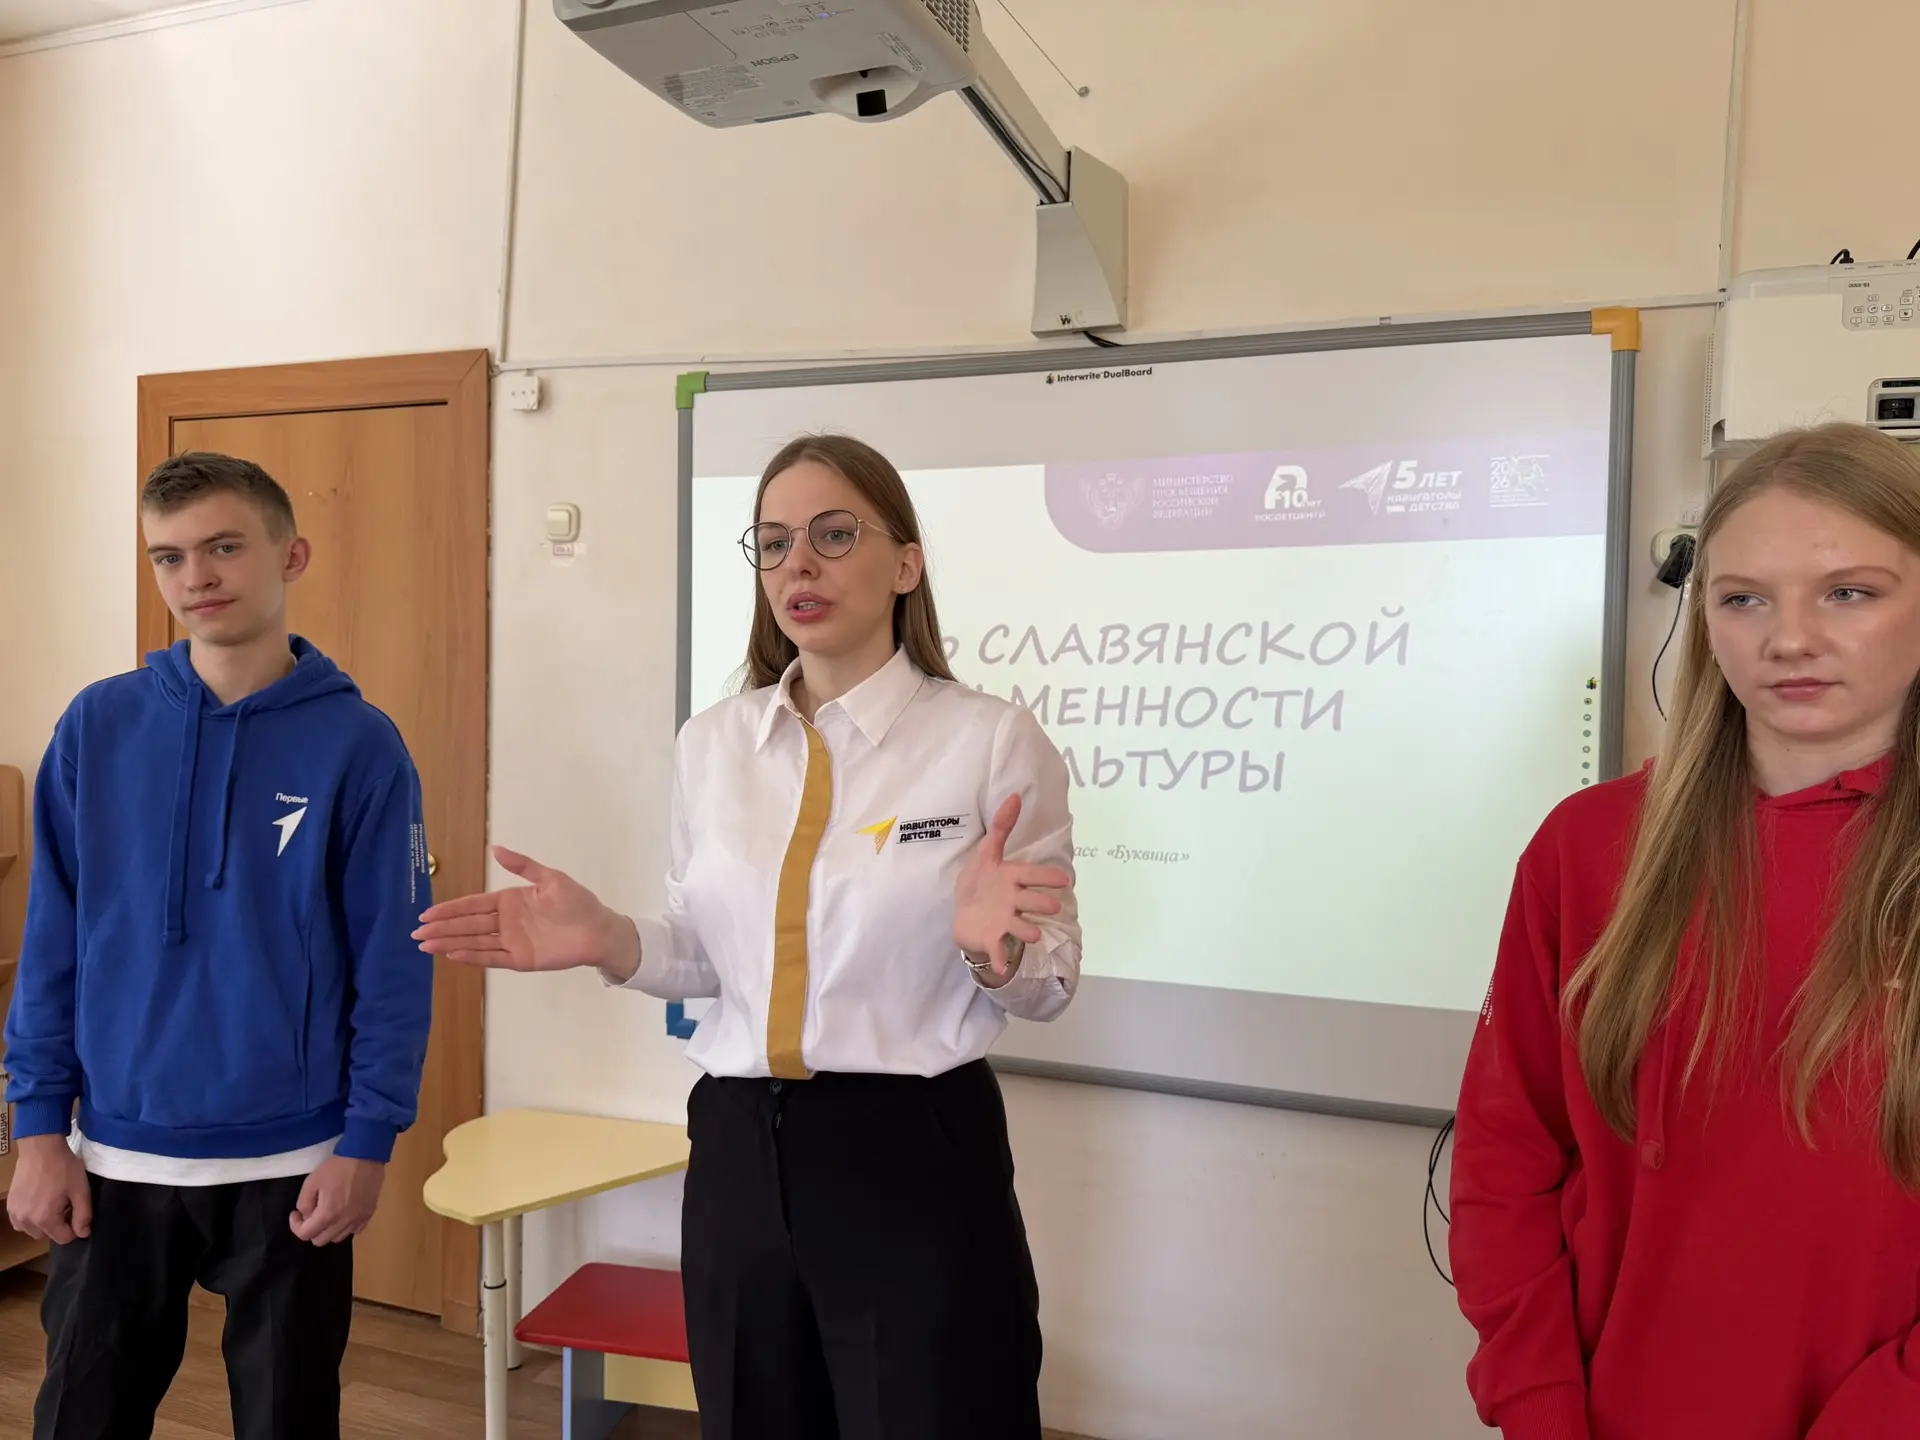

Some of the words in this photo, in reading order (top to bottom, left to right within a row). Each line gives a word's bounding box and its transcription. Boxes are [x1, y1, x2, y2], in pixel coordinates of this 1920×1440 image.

[750, 53, 799, 67] EPSON
[1057, 372, 1101, 383] Interwrite
[1103, 366, 1153, 379] DualBoard
[1392, 459, 1418, 490] 5
[1418, 470, 1464, 489] ЛЕТ
[978, 605, 1410, 667] СЛАВЯНСКОЙ
[1010, 684, 1345, 732] МЕННОСТИ
[1062, 746, 1286, 793] ЛЬТУРЫ
[275, 792, 309, 804] Первые
[900, 817, 960, 831] НАВИГАТОРЫ
[899, 829, 941, 842] ДЕТСТВА
[1074, 845, 1099, 858] асс
[1106, 844, 1190, 864] «Буквица»
